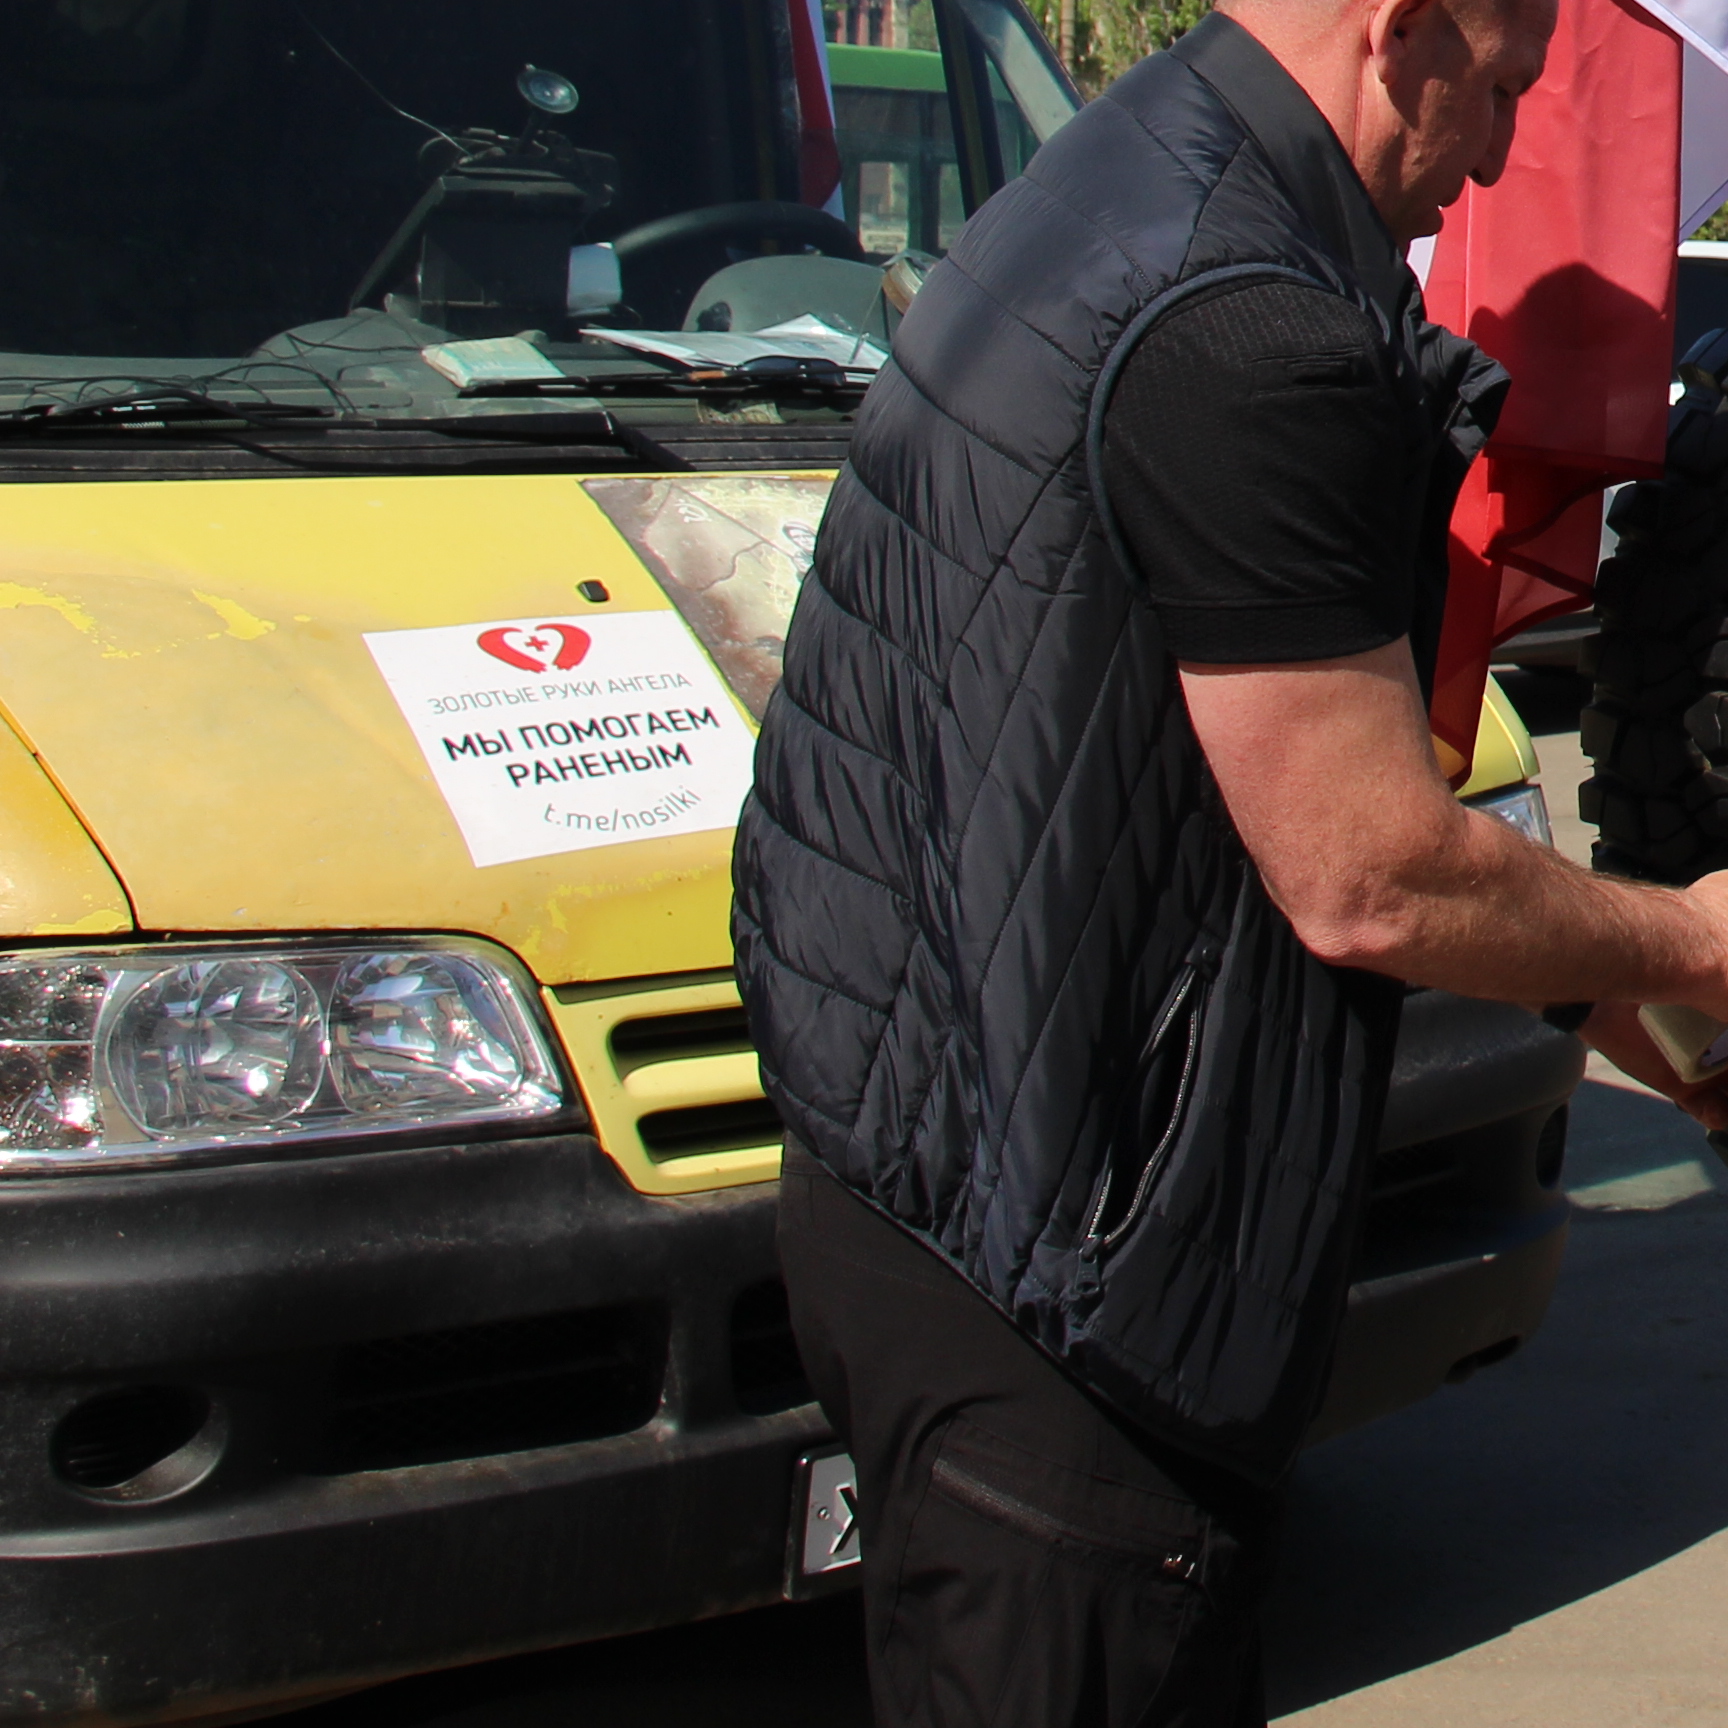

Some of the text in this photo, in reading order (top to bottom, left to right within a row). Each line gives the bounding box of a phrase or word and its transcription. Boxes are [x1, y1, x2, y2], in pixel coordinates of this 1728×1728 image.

[427, 672, 693, 715] ЗОЛОТЫЕ РУКИ АНГЕЛА
[442, 706, 720, 761] МЫ ПОМОГАЕМ
[505, 742, 693, 788] РАНЕНЫМ
[543, 785, 702, 832] t.me/nosilki
